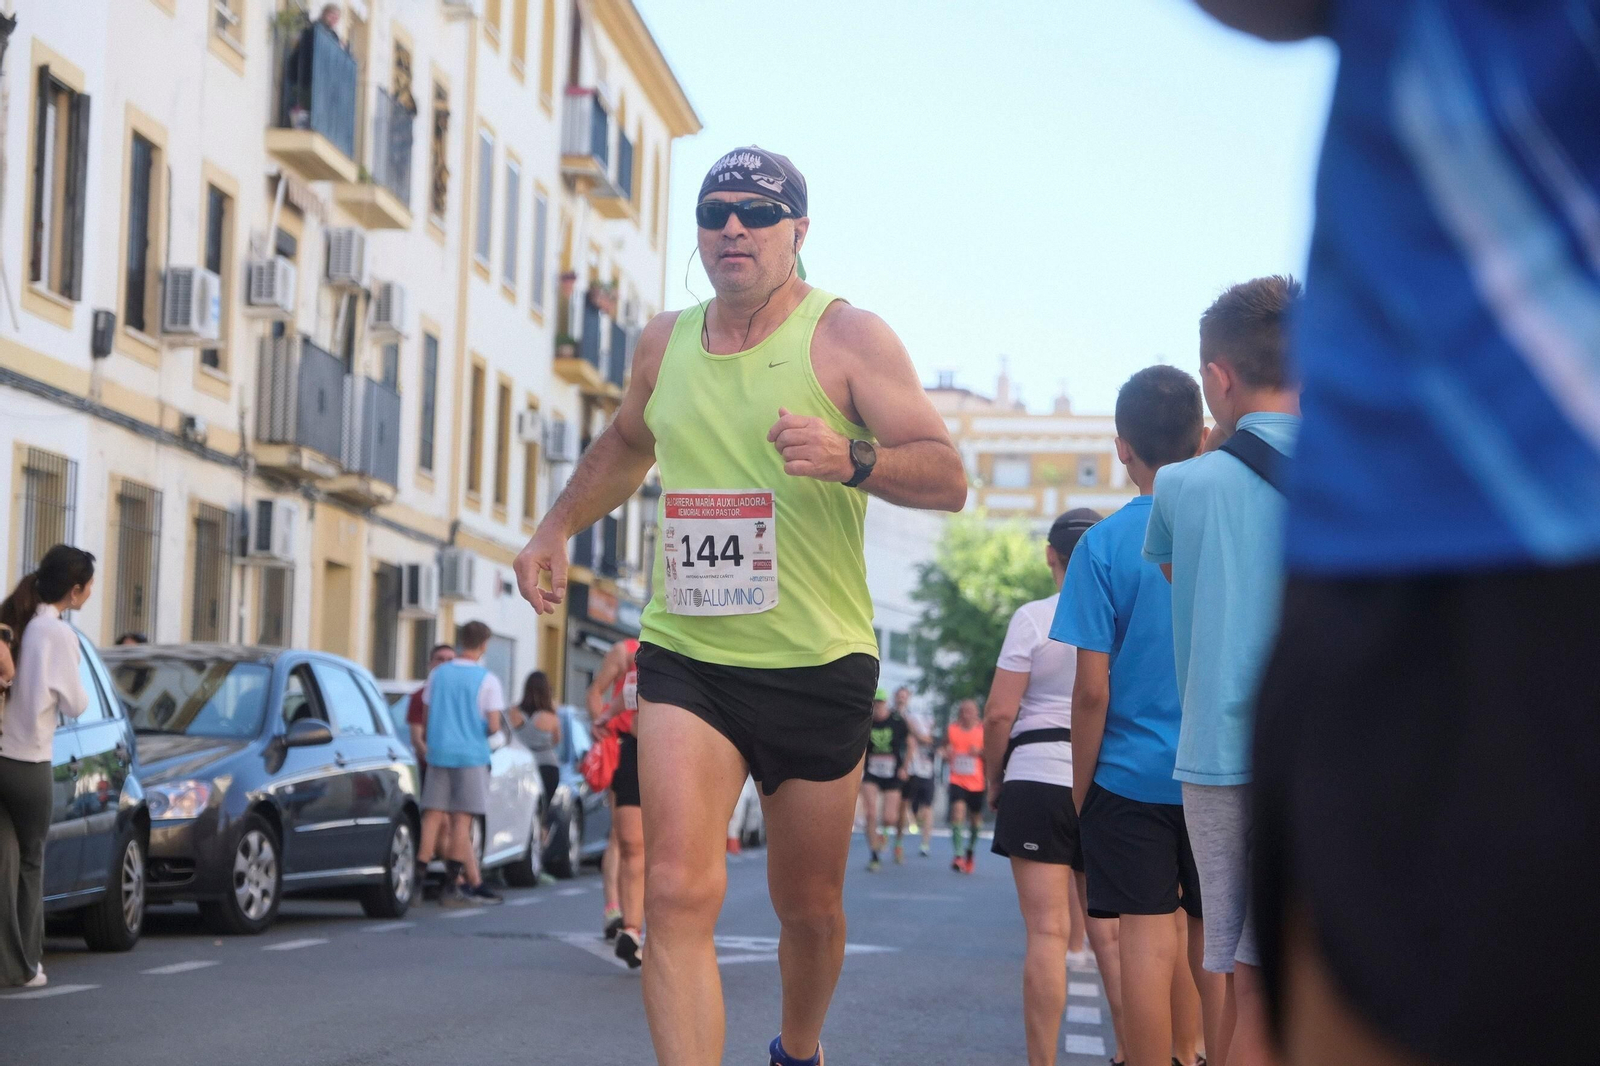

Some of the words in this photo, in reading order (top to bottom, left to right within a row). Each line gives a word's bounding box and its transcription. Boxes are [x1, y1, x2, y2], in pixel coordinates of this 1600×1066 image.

[716, 497, 767, 507] AUXILIADORA
[715, 508, 741, 517] PASTOR
[681, 535, 744, 567] 144
